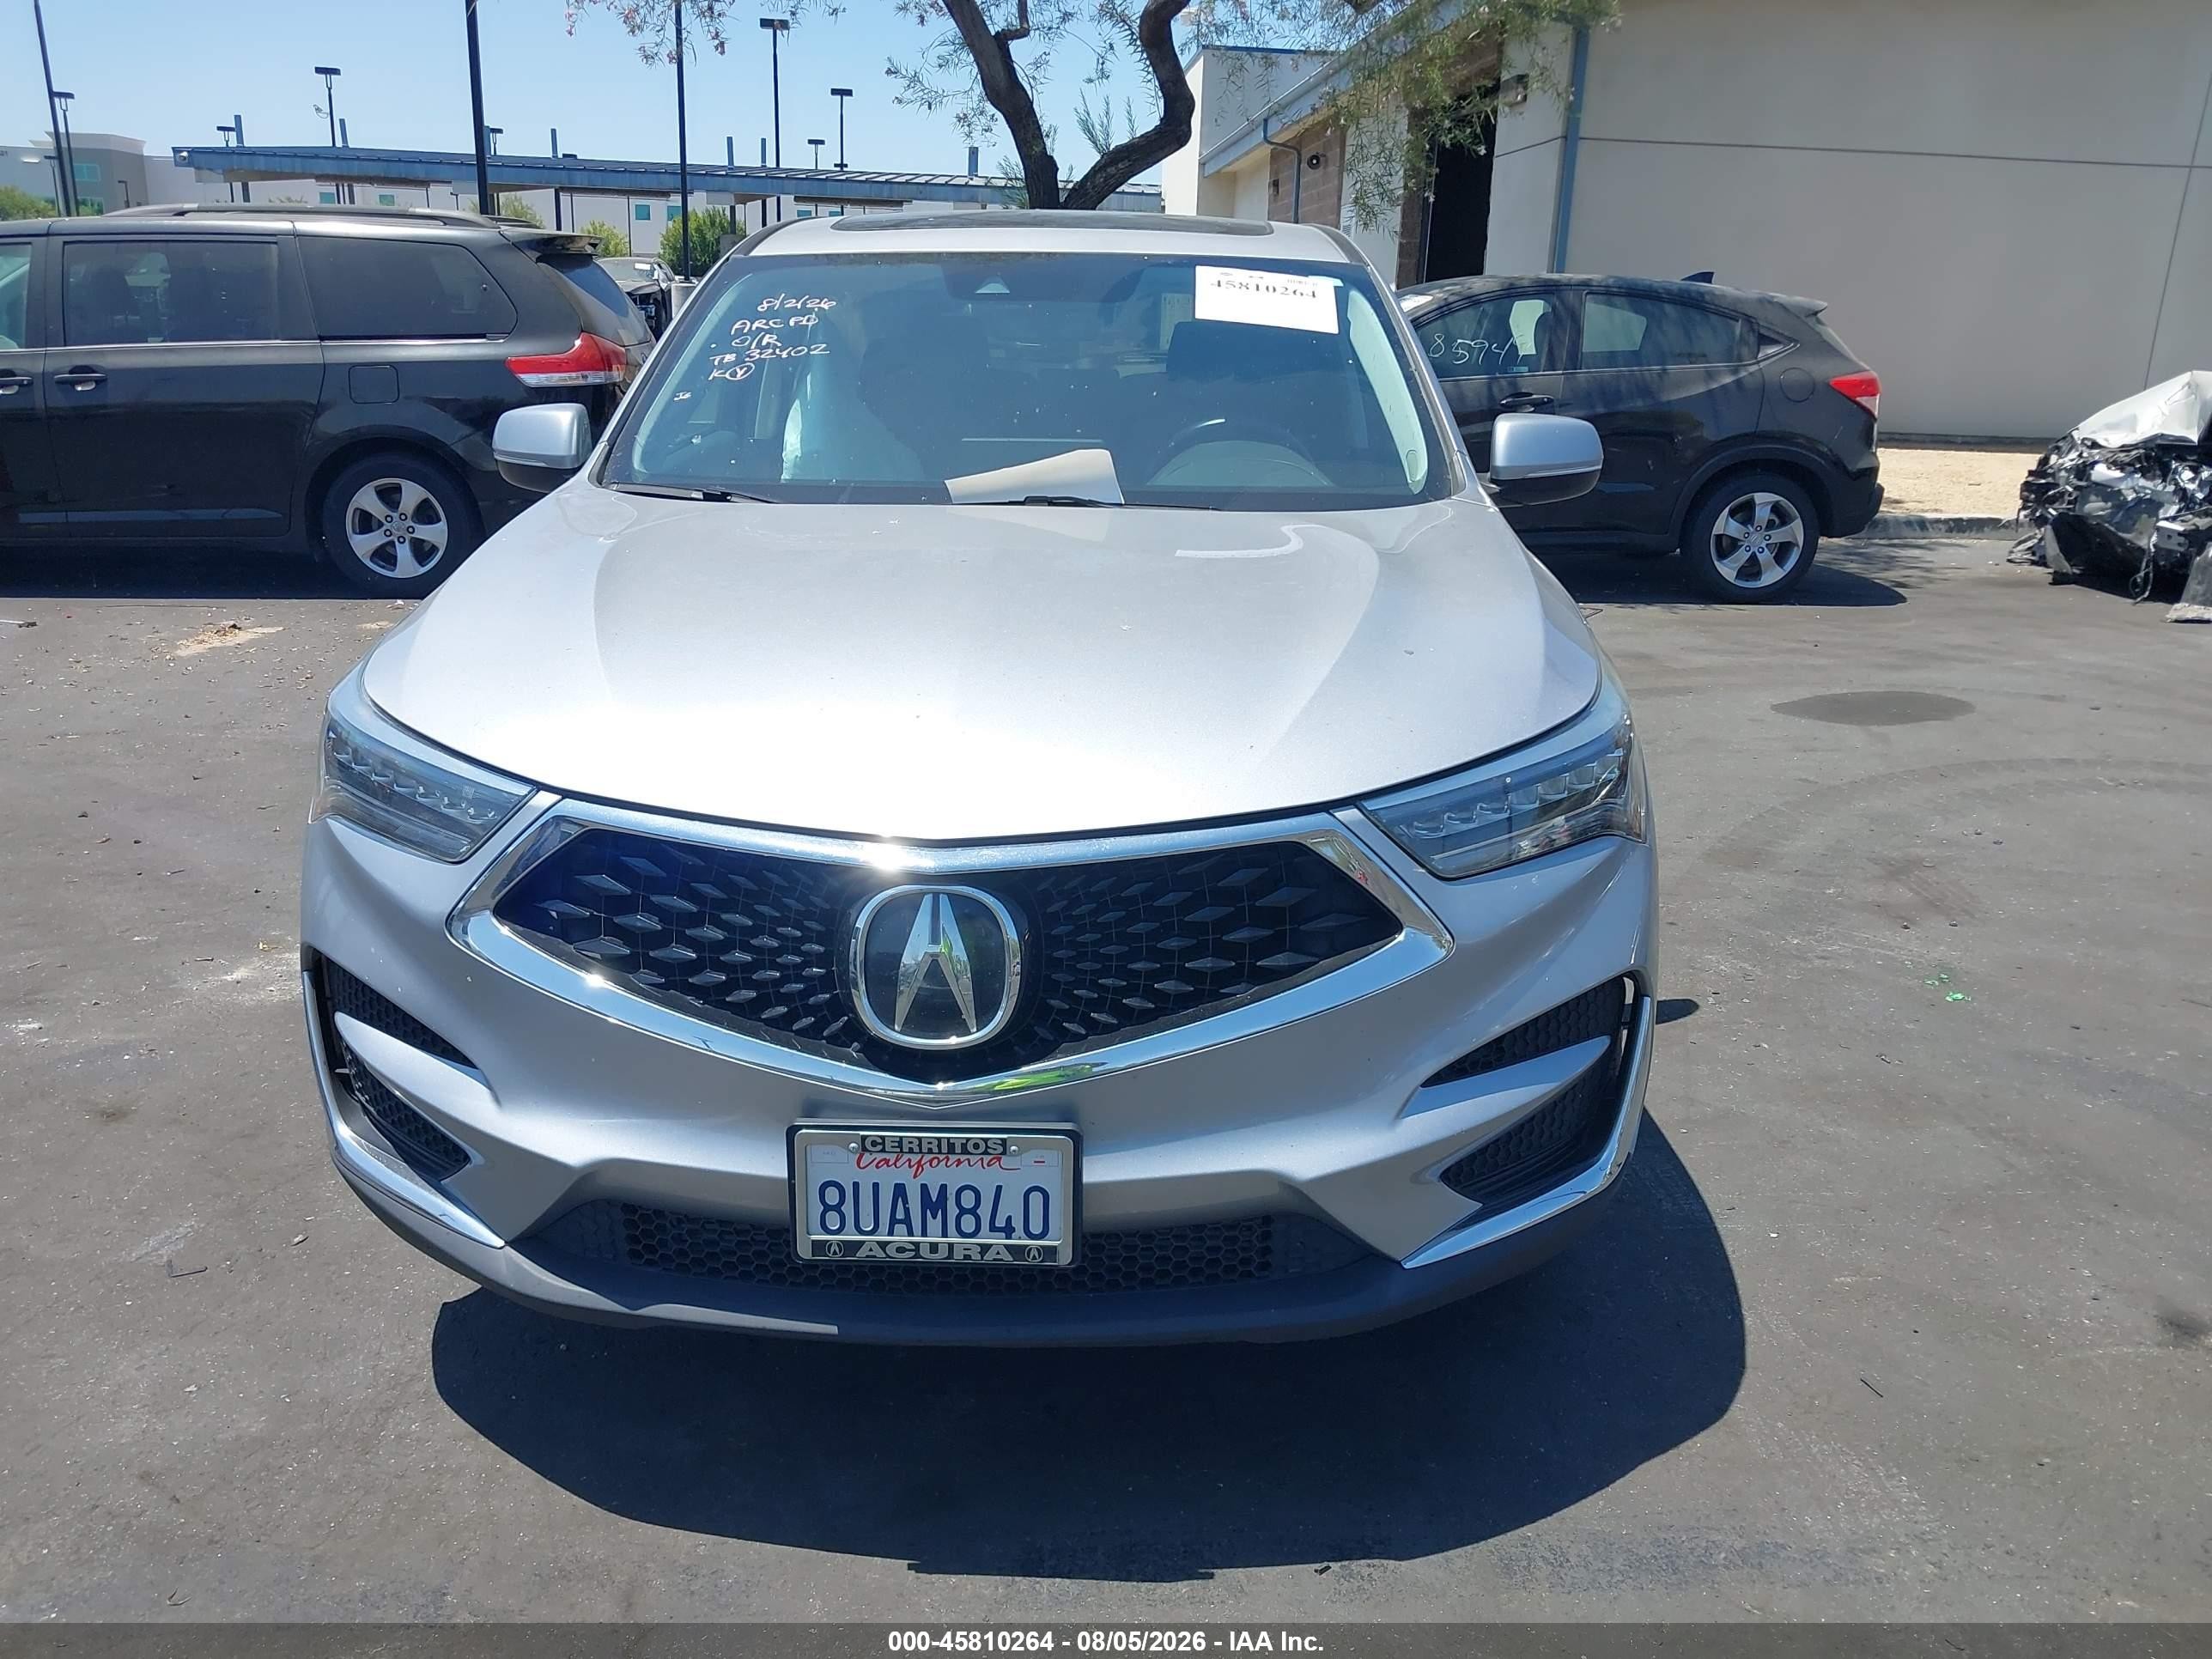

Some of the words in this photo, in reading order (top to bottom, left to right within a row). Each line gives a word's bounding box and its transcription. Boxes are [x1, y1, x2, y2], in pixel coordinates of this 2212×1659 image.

[1210, 280, 1316, 298] 45810264
[757, 293, 836, 312] 8/2/26
[731, 319, 784, 335] ARC
[864, 1135, 1006, 1155] CERRITOS
[856, 1152, 1021, 1179] California
[817, 1180, 1050, 1240] 8UAM840
[855, 1242, 1014, 1261] ACURA
